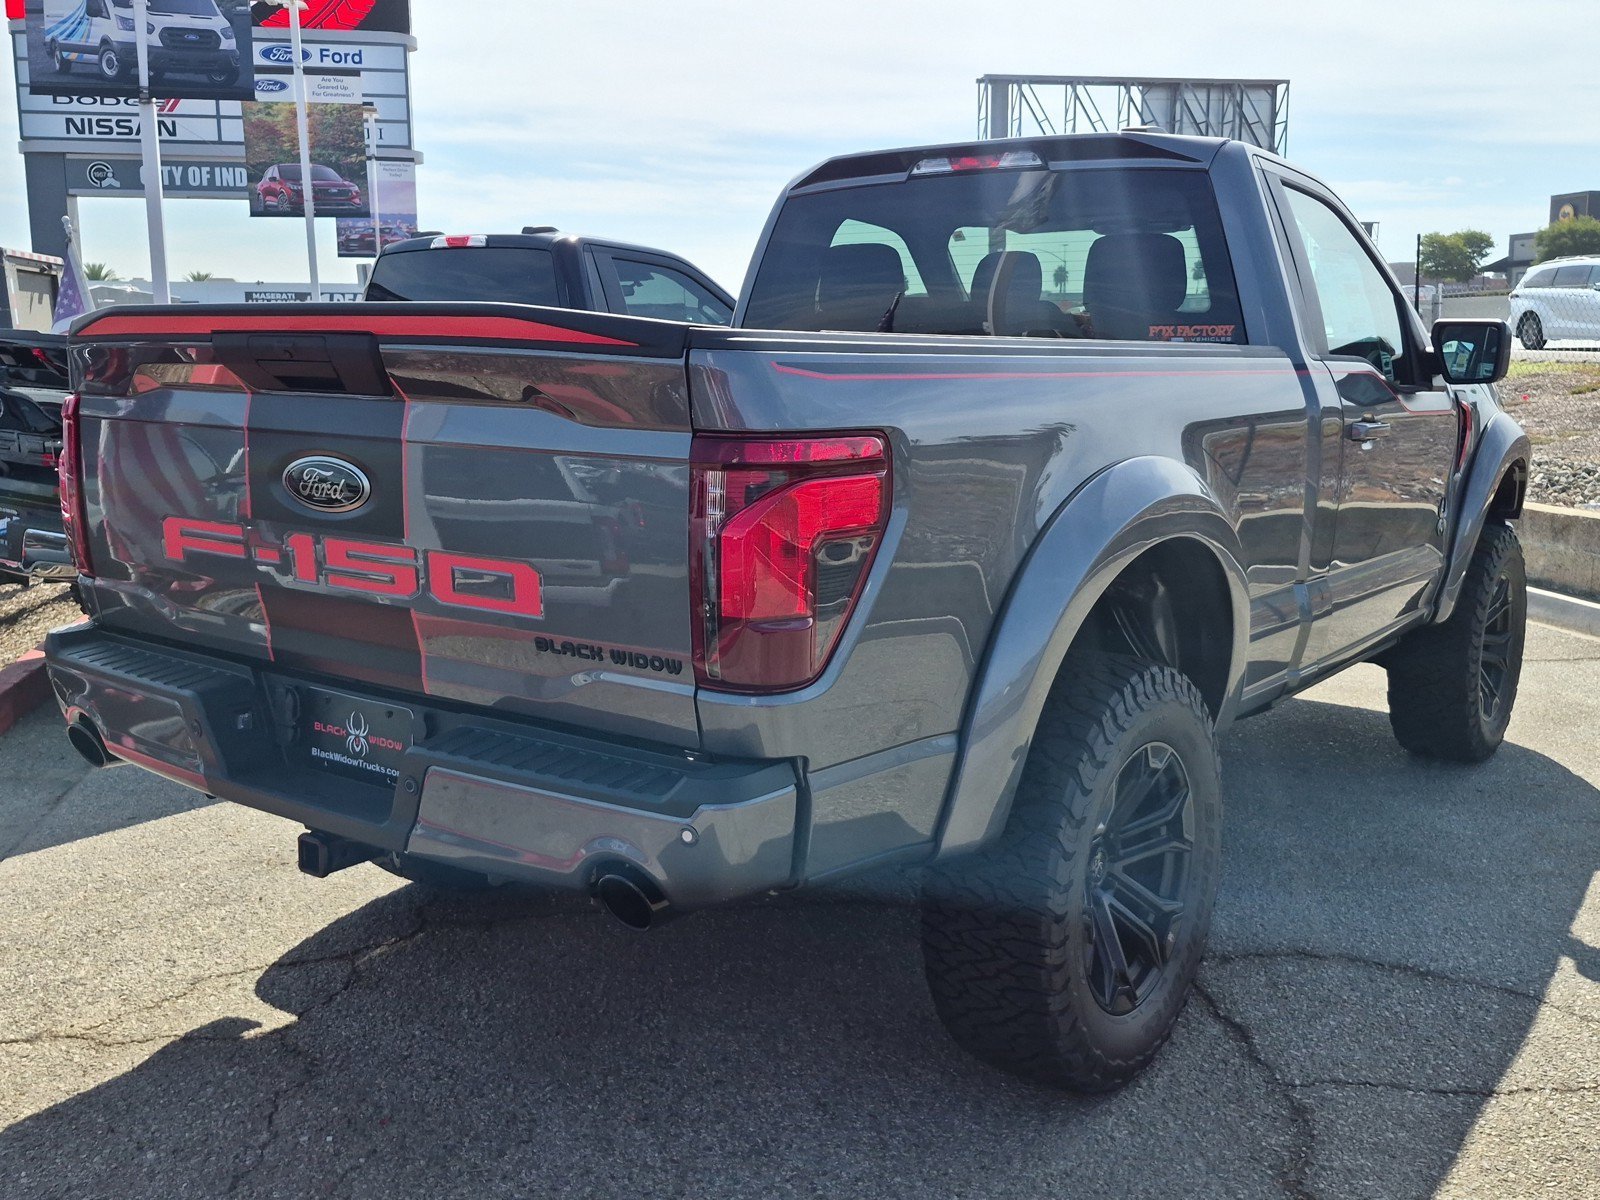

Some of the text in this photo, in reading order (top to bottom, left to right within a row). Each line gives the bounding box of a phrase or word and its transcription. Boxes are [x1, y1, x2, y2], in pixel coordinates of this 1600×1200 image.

[319, 48, 363, 64] Ford
[256, 80, 281, 91] Ford
[187, 166, 211, 187] OF
[1149, 325, 1235, 336] FOX FACTORY
[299, 467, 345, 500] Ford
[162, 516, 544, 619] F-150
[534, 636, 683, 675] BLACK WIDOW
[313, 721, 403, 751] BLACK WIDOW
